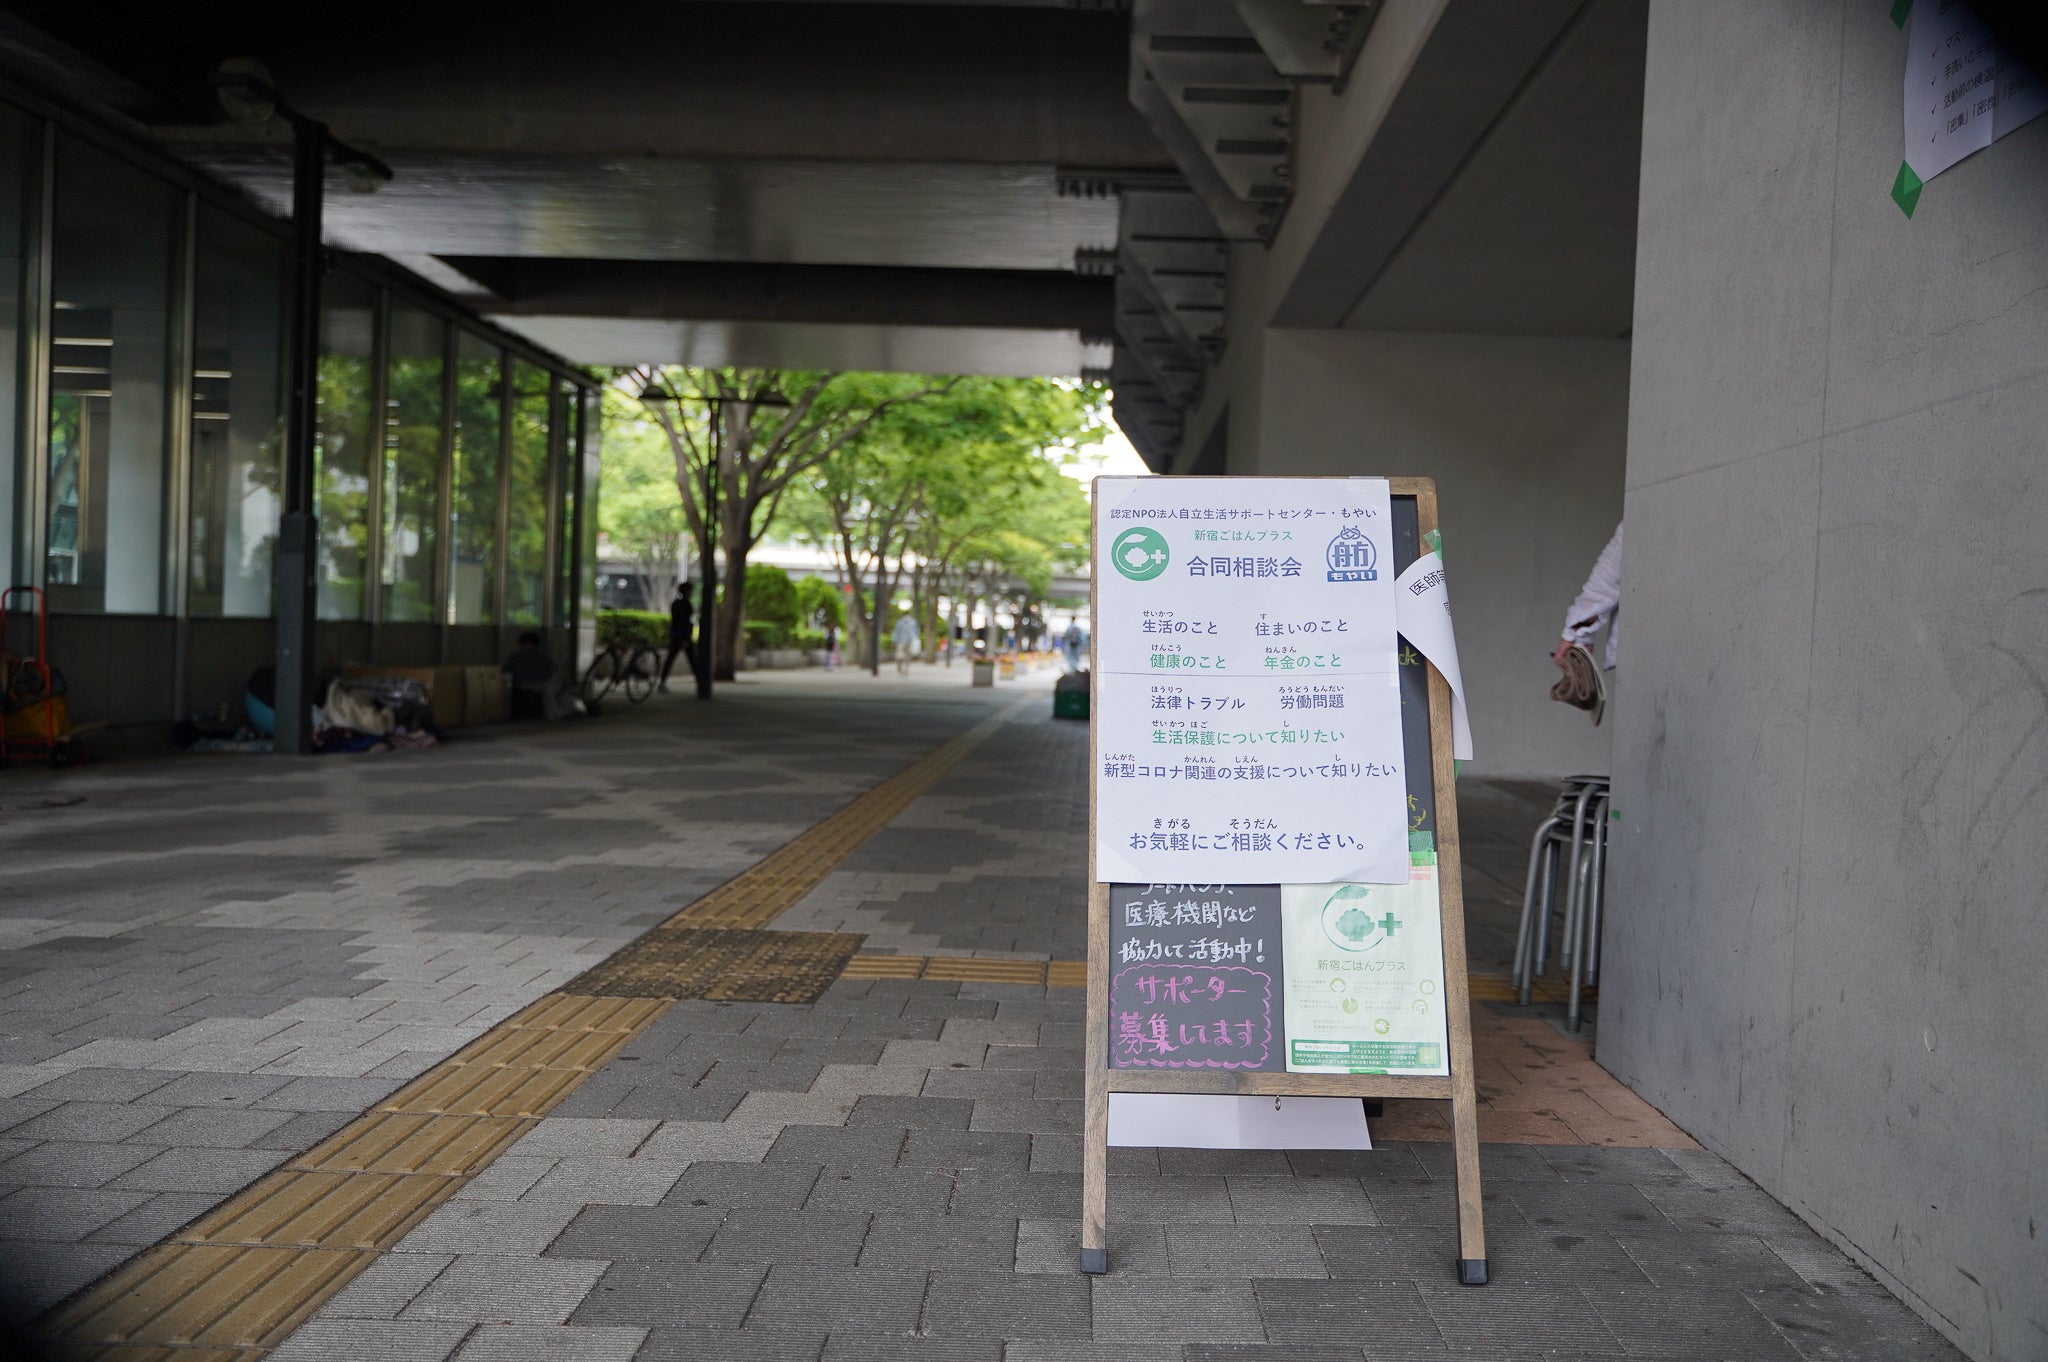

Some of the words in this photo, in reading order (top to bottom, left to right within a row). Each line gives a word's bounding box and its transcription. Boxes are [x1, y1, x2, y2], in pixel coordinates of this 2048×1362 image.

[1110, 507, 1377, 520] 認定NPO法人自立生活サポートセンター・もやい
[1193, 529, 1293, 542] 新宿ごはんプラス
[1186, 556, 1303, 578] 合同相談会
[1330, 571, 1374, 581] もやい
[1142, 609, 1174, 618] せいかつ
[1142, 618, 1218, 635] 生活のこと
[1254, 619, 1349, 637] 住まいのこと
[1151, 643, 1182, 652] けんこう
[1149, 653, 1227, 670] 健康のこと
[1263, 654, 1342, 671] 年金のこと
[1151, 685, 1183, 694] ほうりつ
[1278, 685, 1309, 694] ろうどう
[1313, 685, 1345, 693] もんだい
[1151, 694, 1246, 711] 法律トラブル
[1280, 694, 1345, 710] 労働問題
[1151, 719, 1185, 728] せいかつ
[1152, 729, 1346, 747] 生活保護について知りたい
[1104, 753, 1136, 762] しんがた
[1184, 755, 1216, 764] かんれん
[1235, 755, 1259, 764] しえん
[1104, 762, 1398, 780] 新型コロナ関連の支援について知りたい
[1229, 818, 1278, 830] そうだん
[1129, 831, 1365, 852] お気軽にご相談ください。
[1125, 900, 1257, 929] 医療機関など
[1317, 959, 1407, 972] 新宿ごはんプラス
[1134, 974, 1248, 1005] サポーター
[1118, 1011, 1258, 1055] 募集してます
